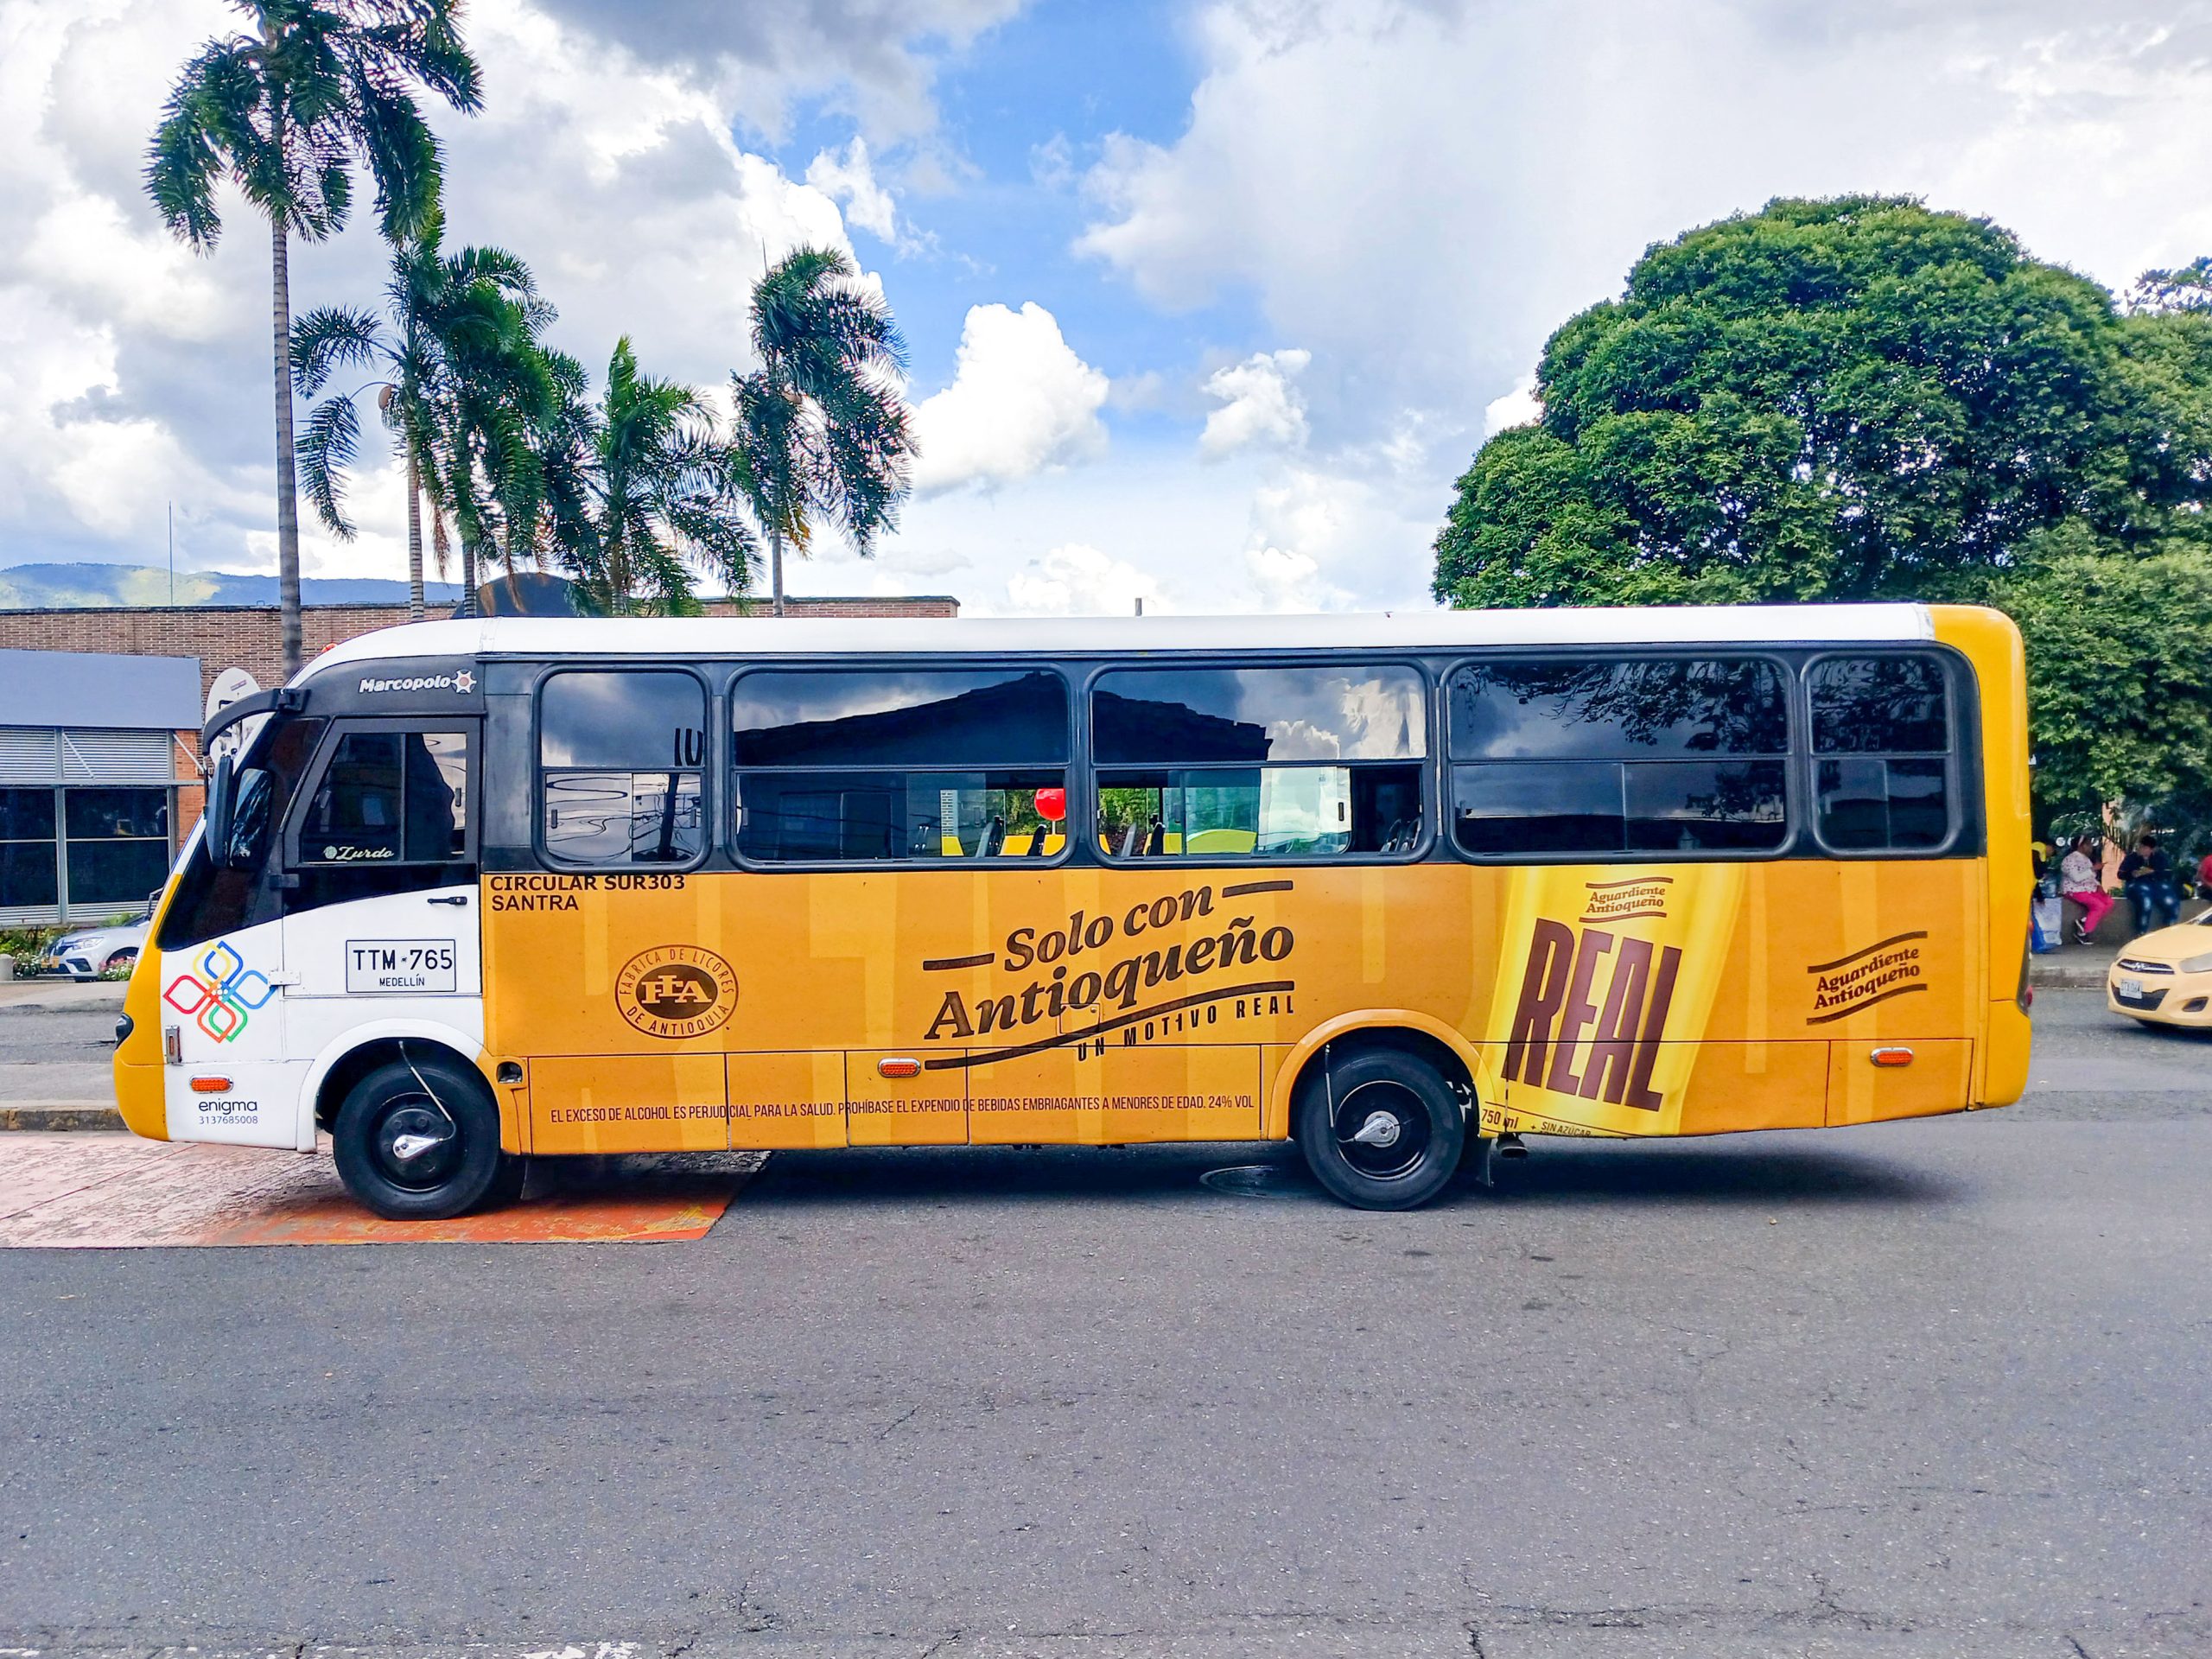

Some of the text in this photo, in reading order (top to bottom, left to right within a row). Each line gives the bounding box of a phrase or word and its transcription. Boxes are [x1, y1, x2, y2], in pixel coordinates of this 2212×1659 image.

[359, 675, 451, 693] Marcopolo
[490, 874, 596, 892] CIRCULAR
[491, 895, 579, 912] SANTRA
[1586, 895, 1664, 913] Antioqueño
[1590, 887, 1666, 905] Aguardiente
[1004, 885, 1215, 972] Solo con
[620, 948, 734, 995] FABRICA DE LICORES
[924, 916, 1294, 1040] Antioqueño
[1816, 949, 1919, 993] Aguardiente
[379, 974, 425, 987] MEDELLÍN
[1814, 963, 1920, 1010] Antioqueño
[626, 1004, 730, 1035] DE ANTIOQUIA
[1501, 918, 1682, 1112] REAL
[1077, 1037, 1105, 1062] UN
[1236, 995, 1294, 1019] REAL
[199, 1098, 257, 1116] enigma
[550, 1095, 1255, 1122] EL EXCESO DE ALCOHOL ES PERJUDCIAL PARA LA SALUD. PROHÍBASE EL EXPENDIO DE BEBIDAS EMBRIAGANTES A MENORES DE EDAD. 24% VOL
[199, 1116, 258, 1125] 3137685008
[1481, 1109, 1501, 1125] 750
[1541, 1122, 1556, 1132] SIN
